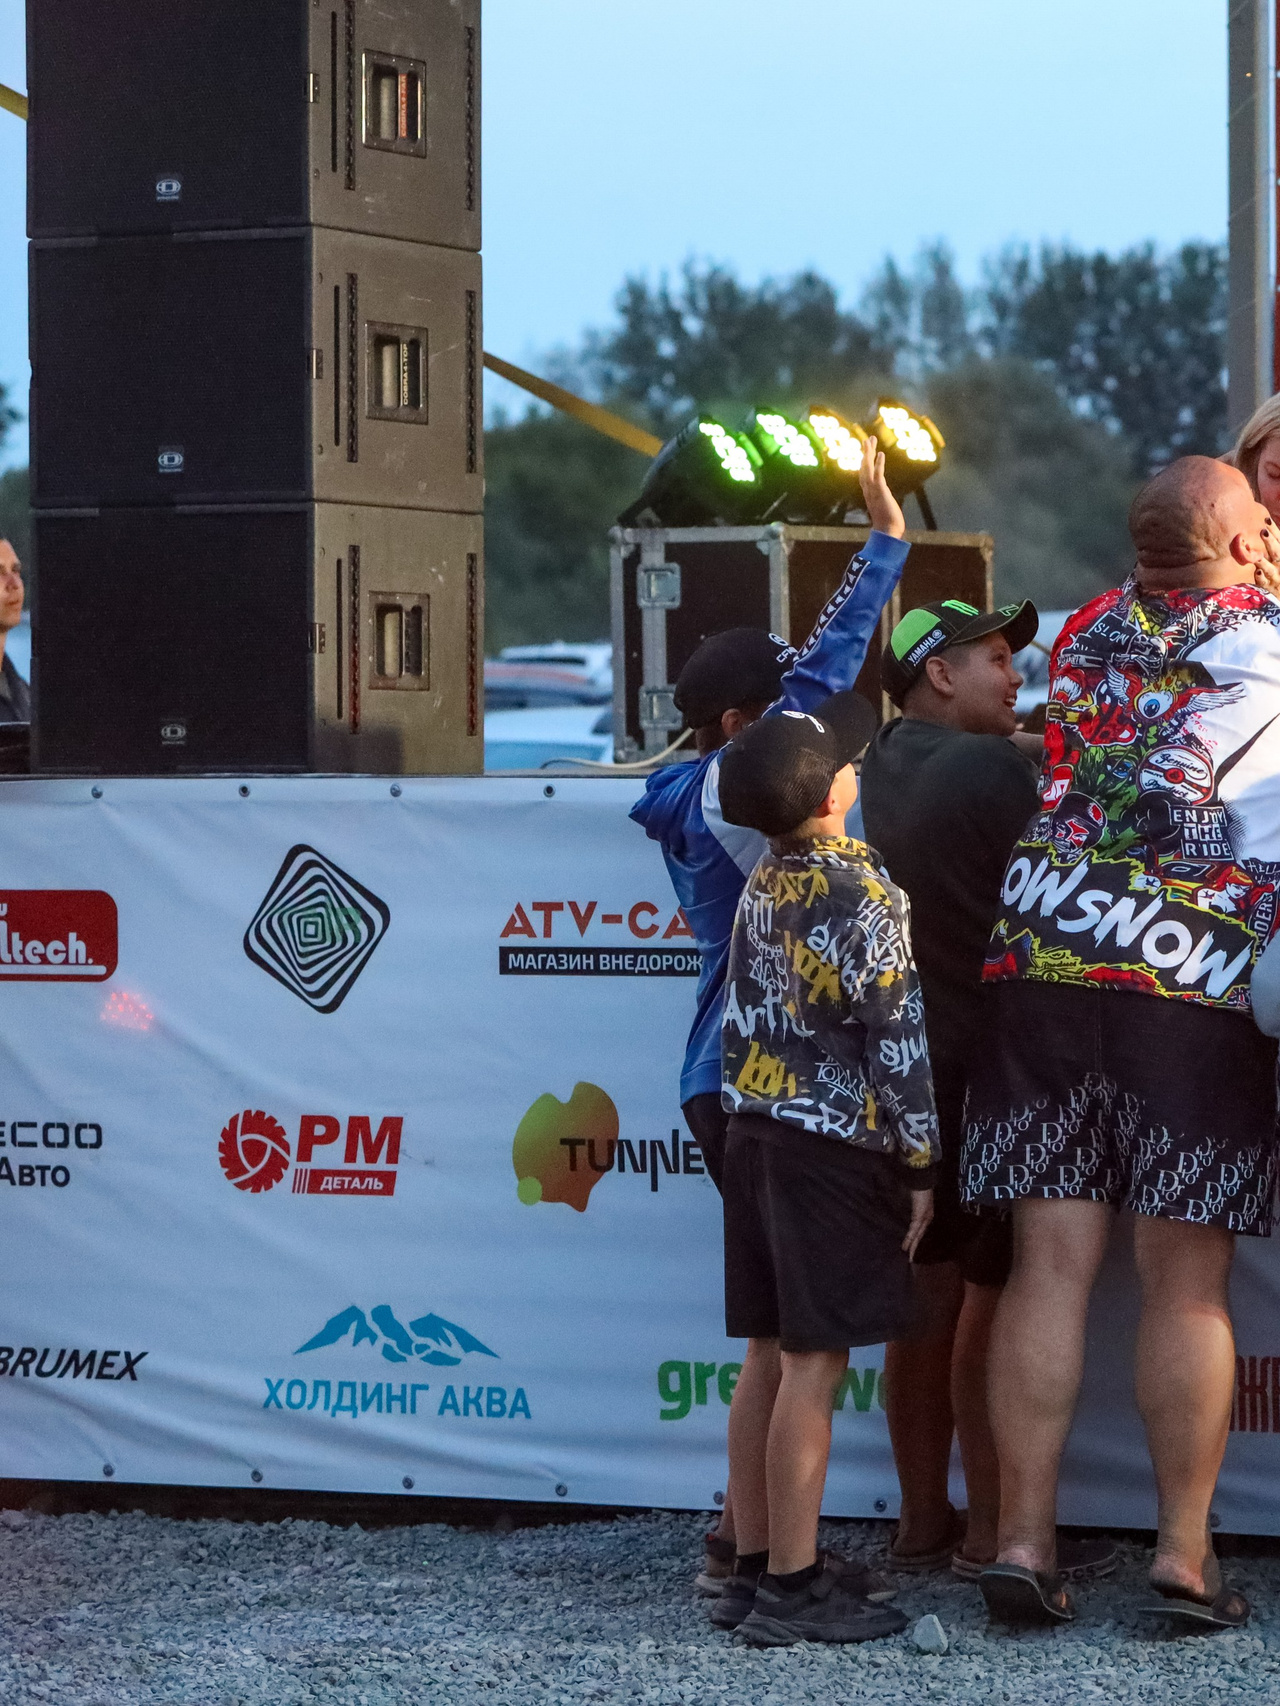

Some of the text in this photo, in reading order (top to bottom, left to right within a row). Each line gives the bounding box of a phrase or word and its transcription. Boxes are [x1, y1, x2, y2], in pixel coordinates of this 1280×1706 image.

[908, 636, 935, 664] YAMAHA
[1155, 753, 1205, 774] Genuine
[1145, 779, 1188, 798] Product
[1173, 810, 1223, 823] ENJOY
[1184, 823, 1222, 841] THE
[1185, 843, 1231, 857] RIDE
[508, 954, 702, 972] МАГАЗИН ВНЕДОРОЖ
[296, 1114, 403, 1164] РМ
[320, 1176, 383, 1192] ДЕТАЛЬ
[262, 1378, 532, 1420] ХОЛДИНГ АКВА
